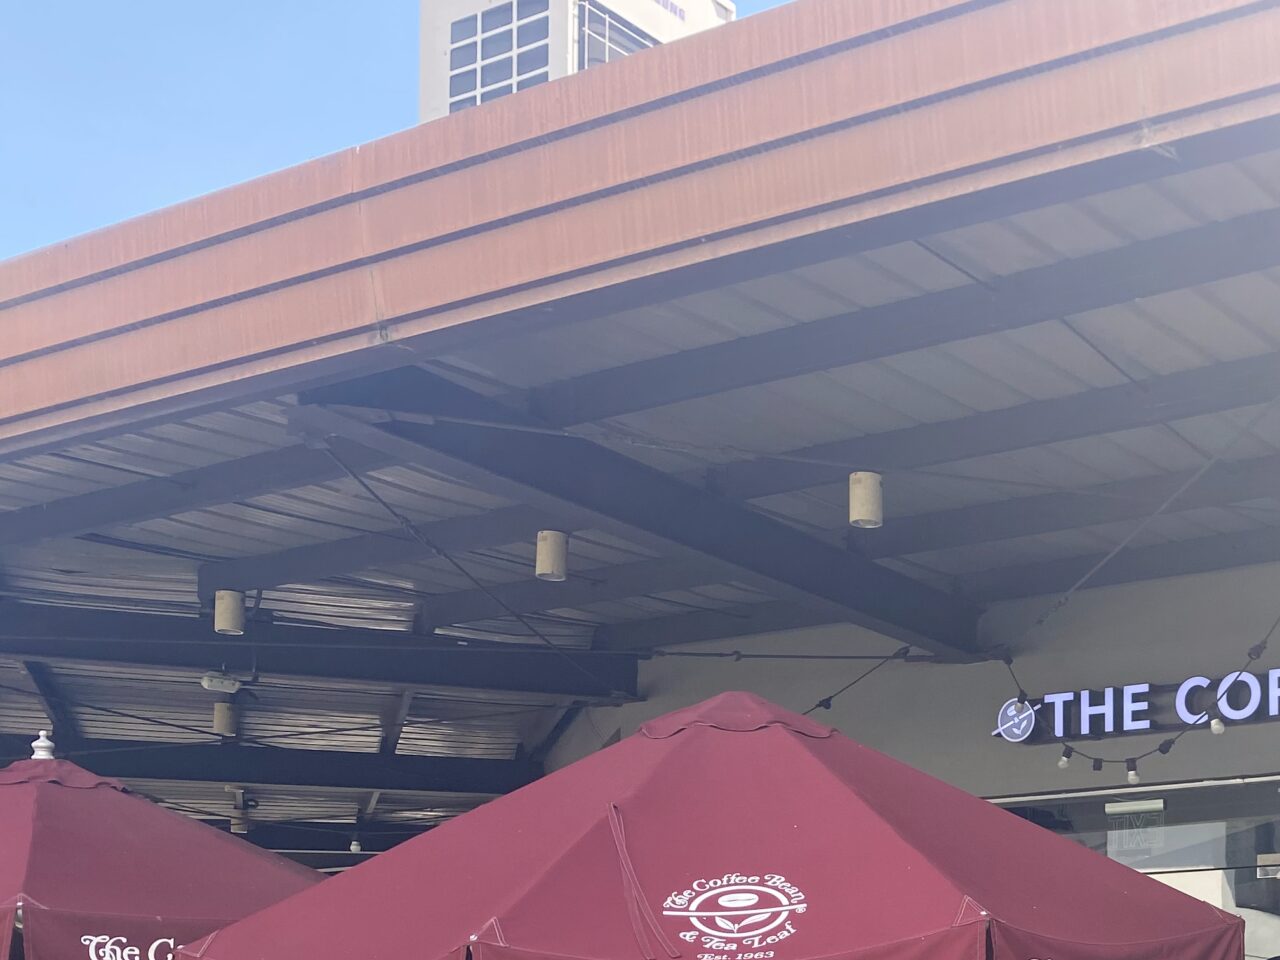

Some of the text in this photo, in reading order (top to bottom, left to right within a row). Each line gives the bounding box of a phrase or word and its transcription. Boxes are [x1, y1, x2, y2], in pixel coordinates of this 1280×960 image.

[1043, 683, 1151, 737] THE
[663, 873, 805, 909] The Coffee Bean
[701, 936, 737, 950] Tea
[743, 921, 797, 948] Leaf
[735, 951, 775, 960] 1963
